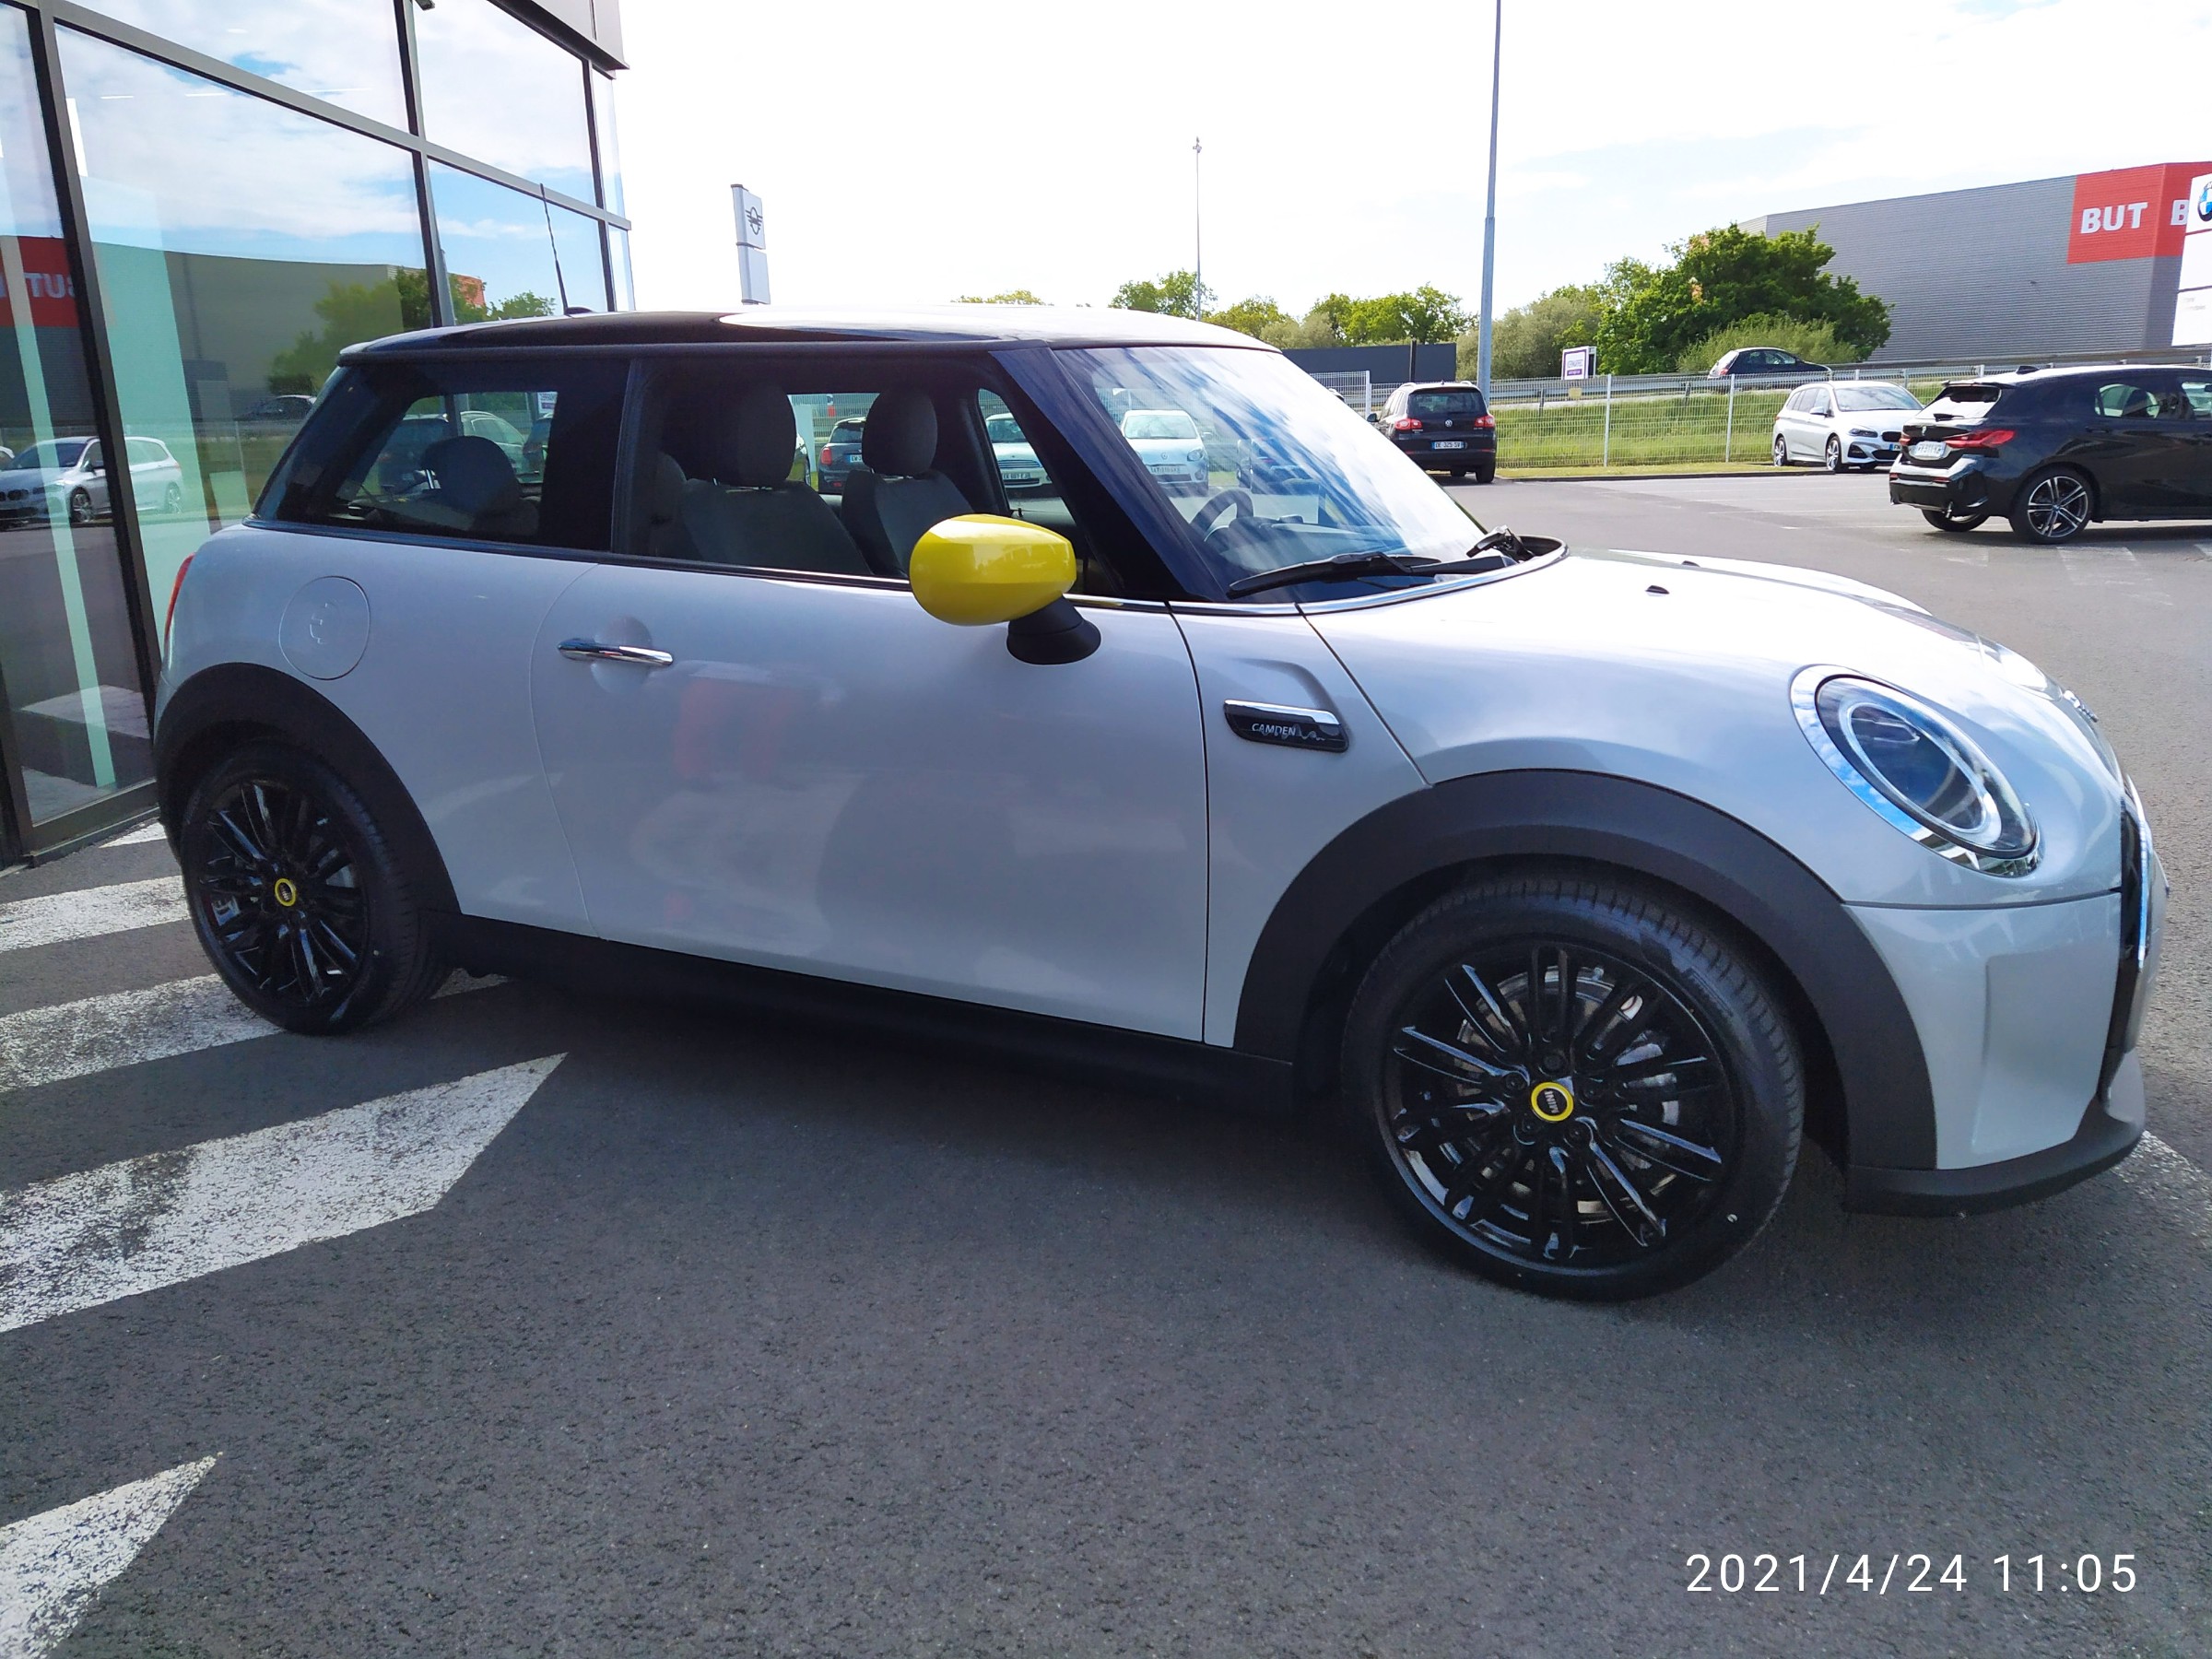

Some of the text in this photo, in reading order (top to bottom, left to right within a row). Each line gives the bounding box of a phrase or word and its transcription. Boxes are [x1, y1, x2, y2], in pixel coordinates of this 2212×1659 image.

[2080, 201, 2148, 234] BUT
[1252, 723, 1296, 736] CAMDEN
[1544, 1090, 1559, 1113] MINI
